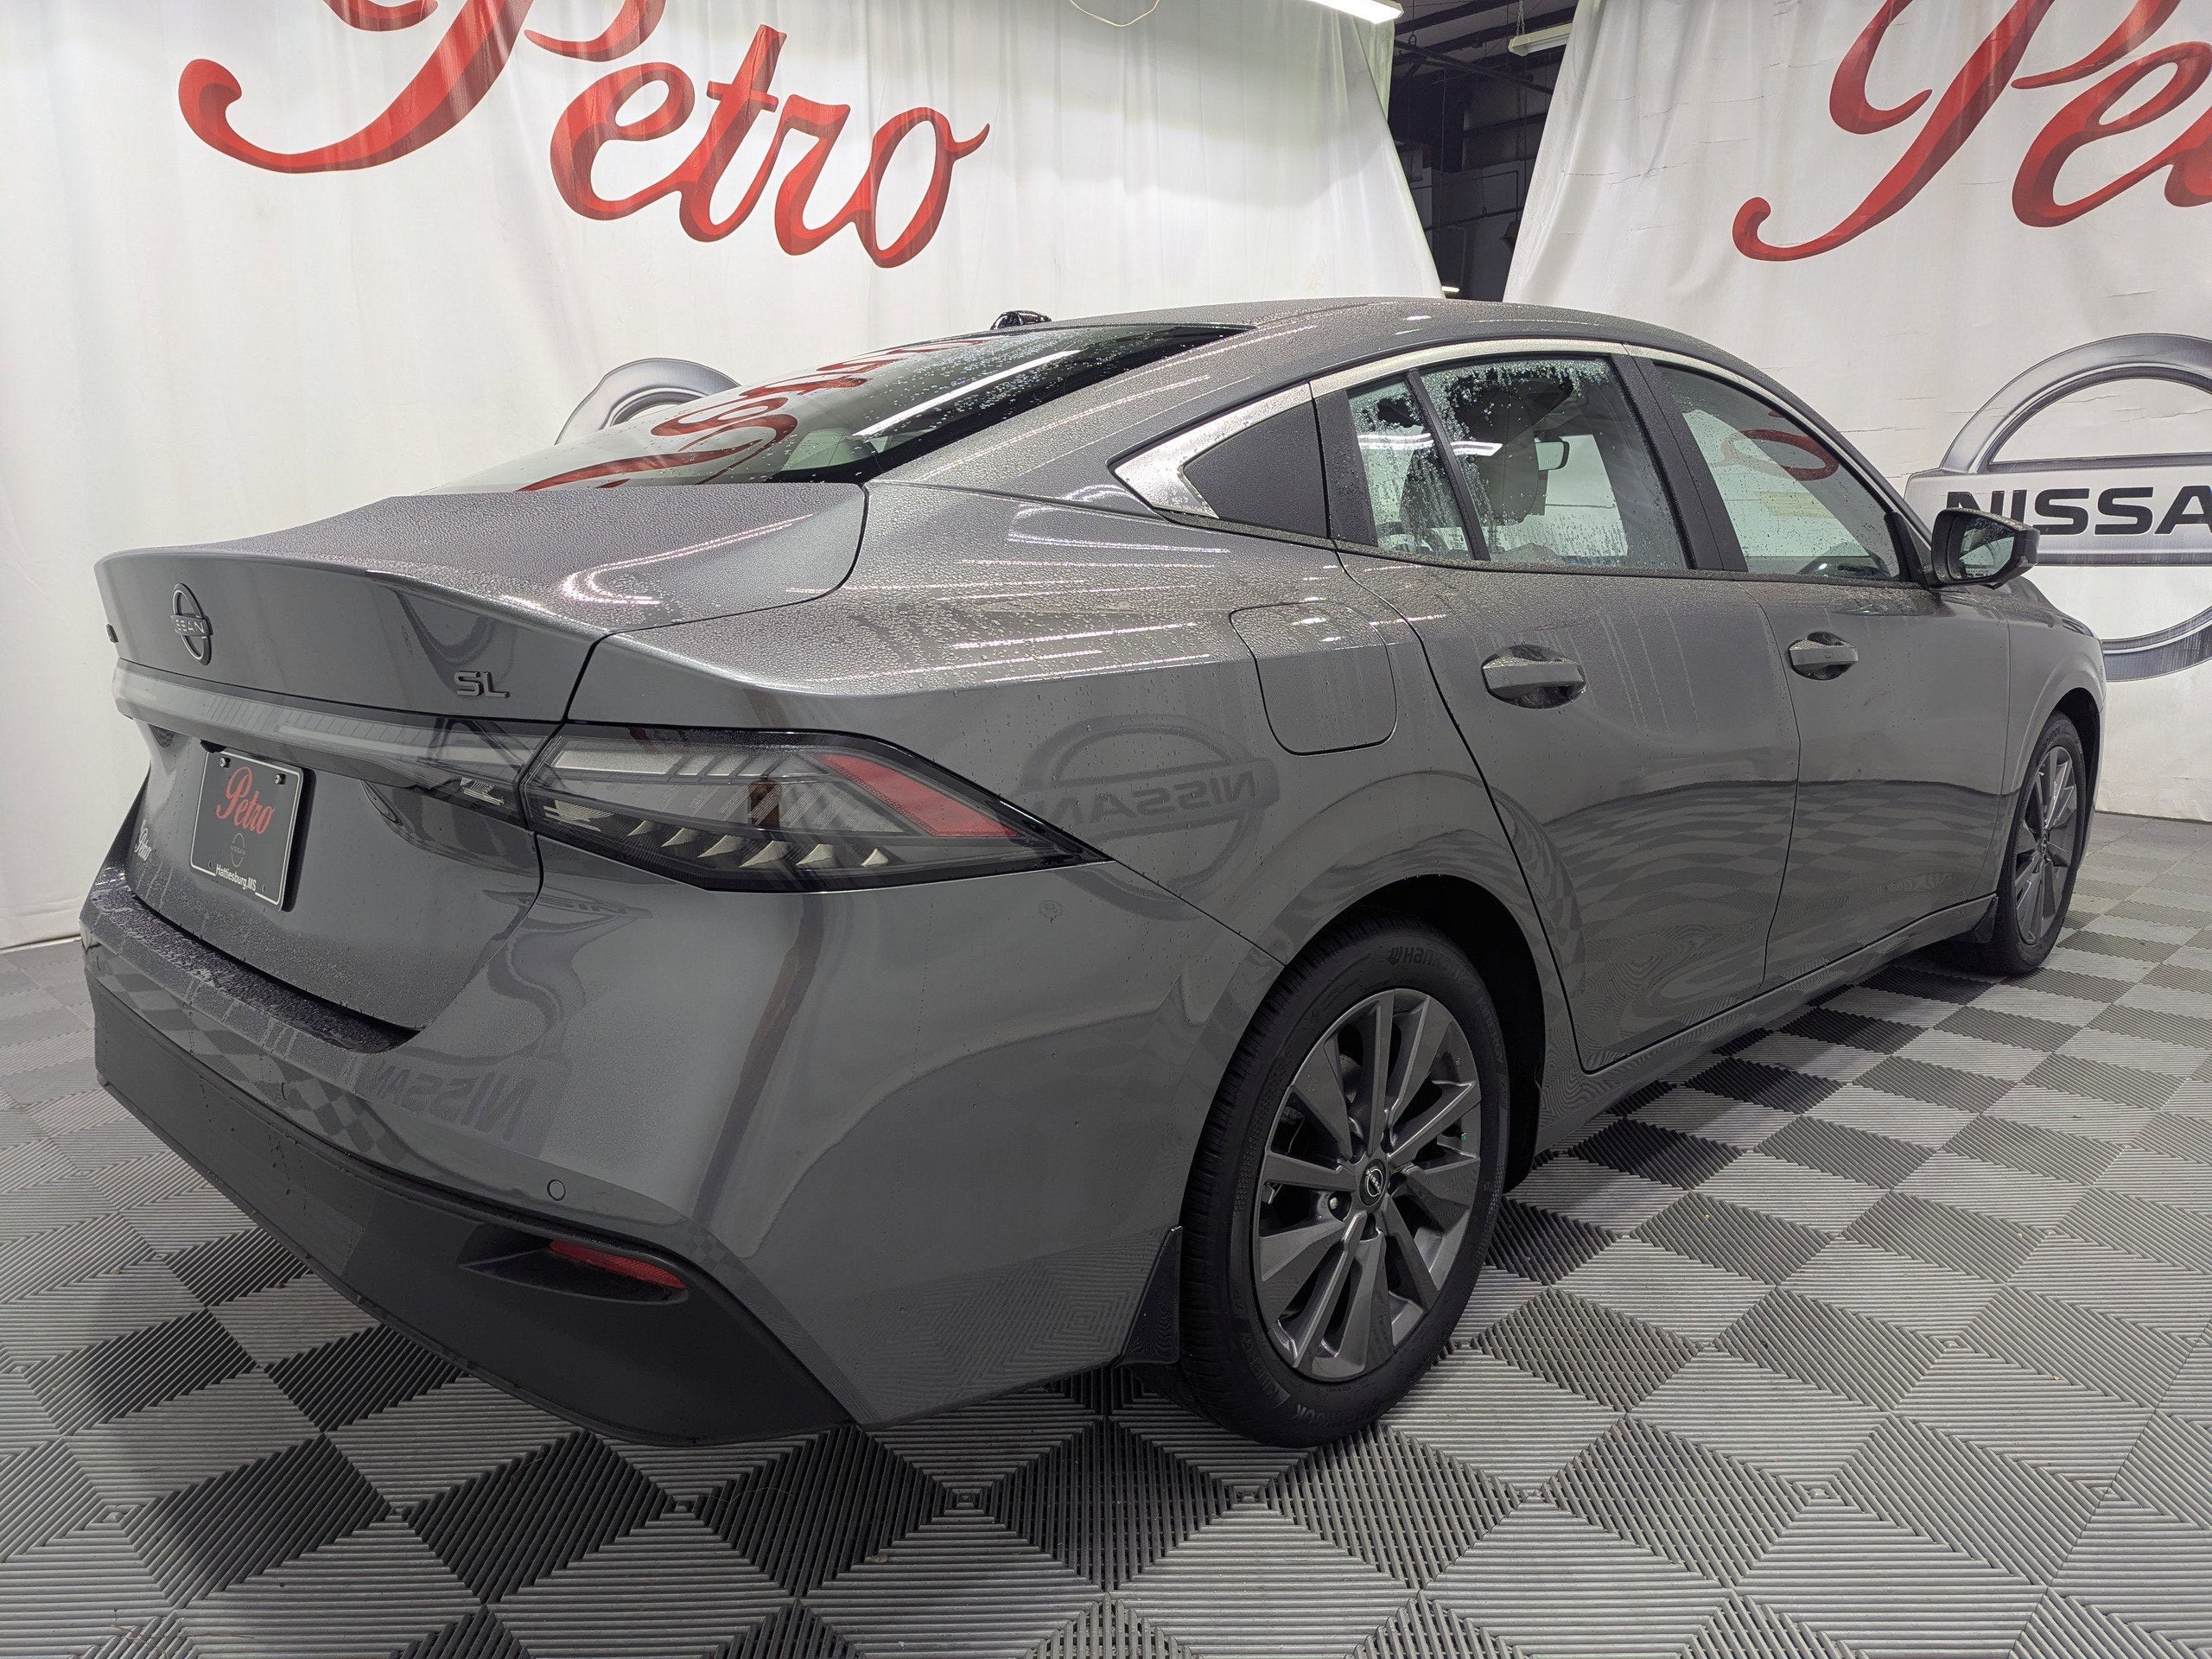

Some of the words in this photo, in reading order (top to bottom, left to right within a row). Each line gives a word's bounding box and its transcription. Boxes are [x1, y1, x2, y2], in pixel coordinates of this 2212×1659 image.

[1732, 0, 2212, 261] Pe
[454, 670, 510, 698] SL
[216, 766, 276, 835] Petro
